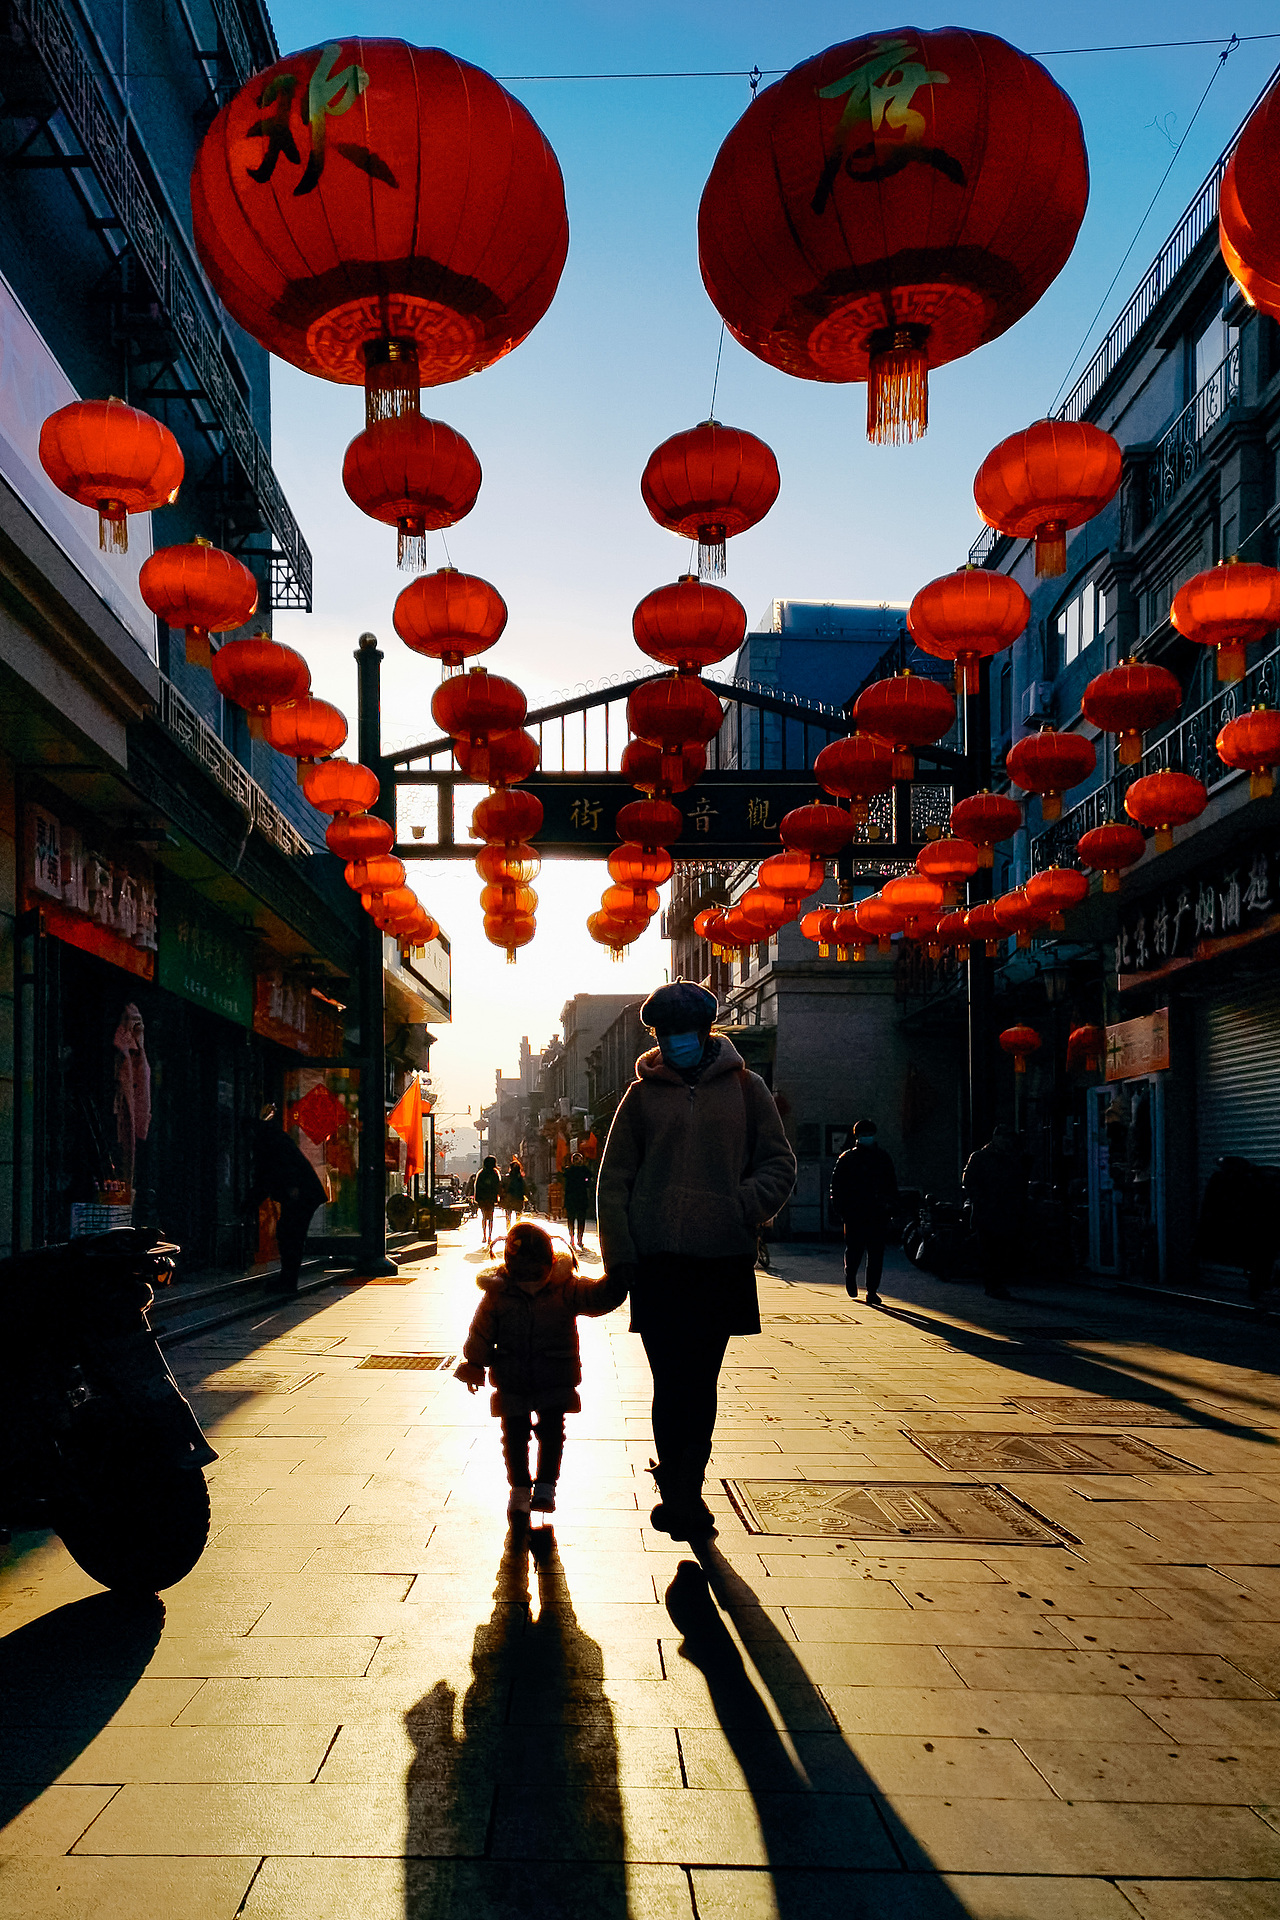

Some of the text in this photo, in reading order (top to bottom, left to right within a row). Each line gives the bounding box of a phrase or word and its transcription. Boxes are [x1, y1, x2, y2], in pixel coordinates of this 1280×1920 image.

[812, 38, 968, 215] 度
[1114, 852, 1280, 974] 北京特产烟酒超
